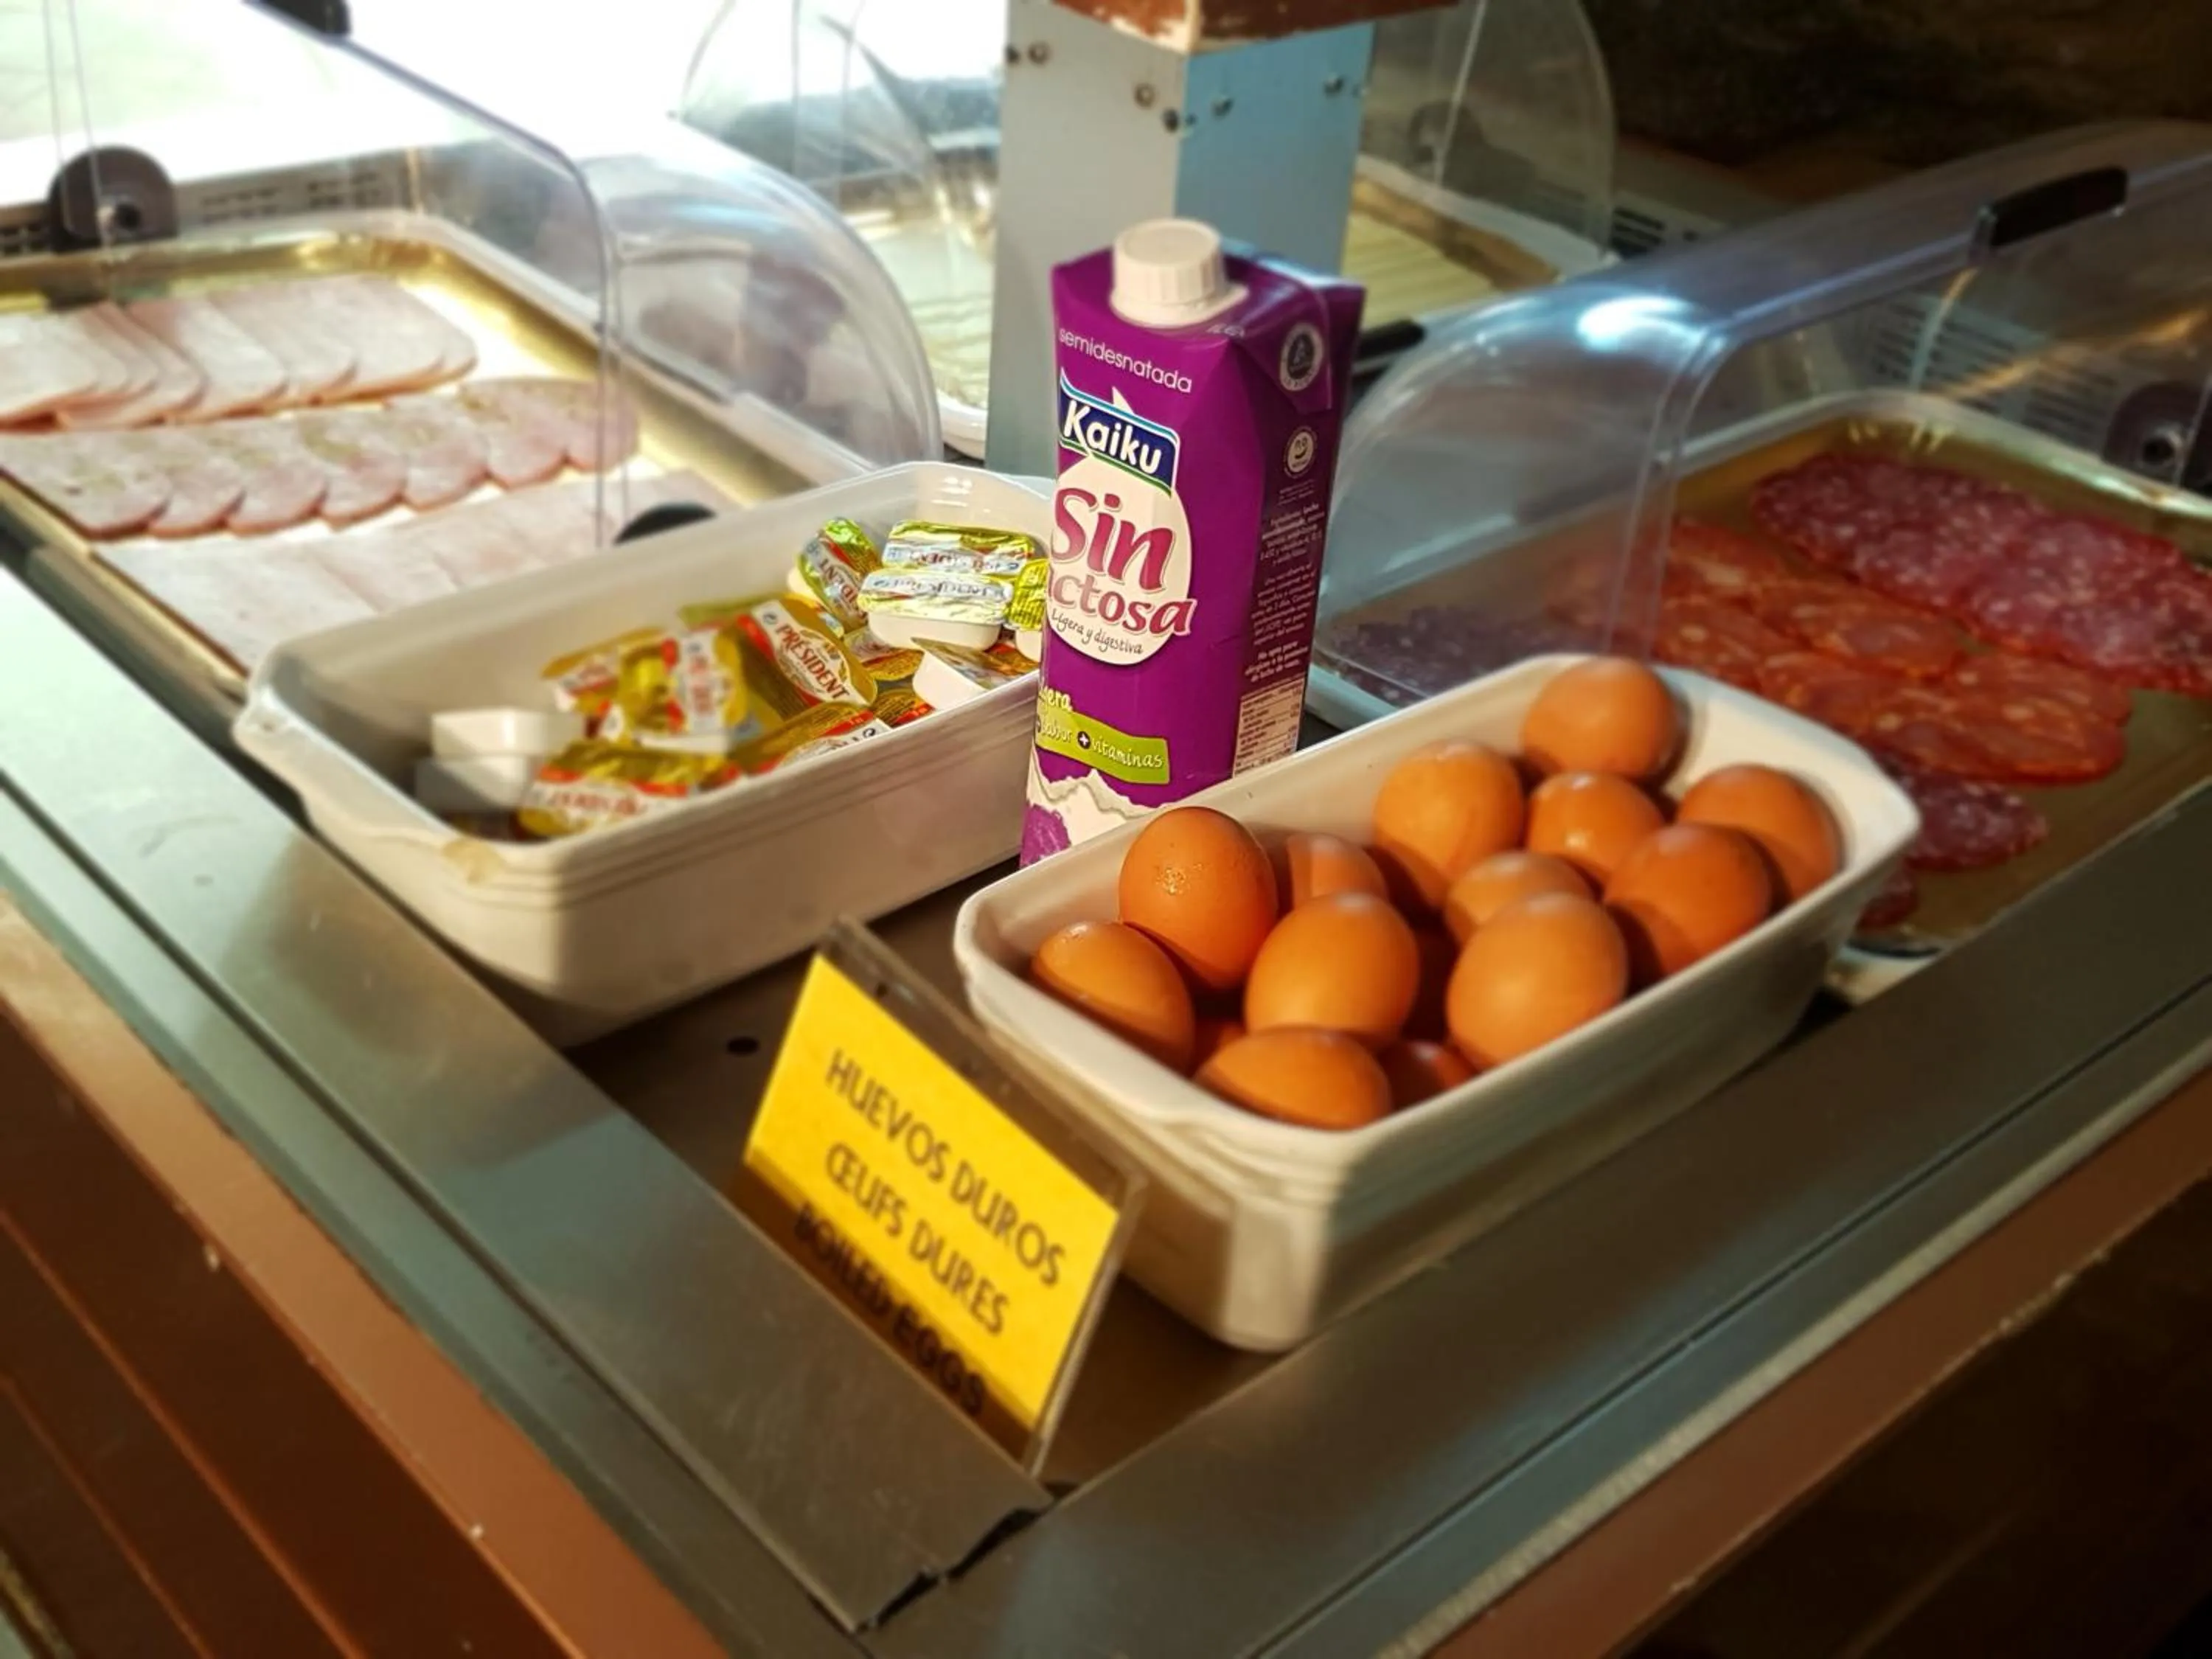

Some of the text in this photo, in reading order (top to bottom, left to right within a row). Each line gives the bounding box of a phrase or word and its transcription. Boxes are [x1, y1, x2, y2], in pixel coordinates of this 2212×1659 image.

[1059, 328, 1192, 393] semidesnatada
[1063, 399, 1162, 474] Kaiku
[1051, 487, 1175, 591] Sin
[1048, 565, 1193, 636] ctosa
[1051, 607, 1144, 655] Ligera y digestiva
[1091, 736, 1164, 768] vitaminas
[825, 1048, 1067, 1288] HUEVOS DUROS
[826, 1142, 1010, 1336] ŒUFS DURES
[891, 1305, 986, 1417] EGGS
